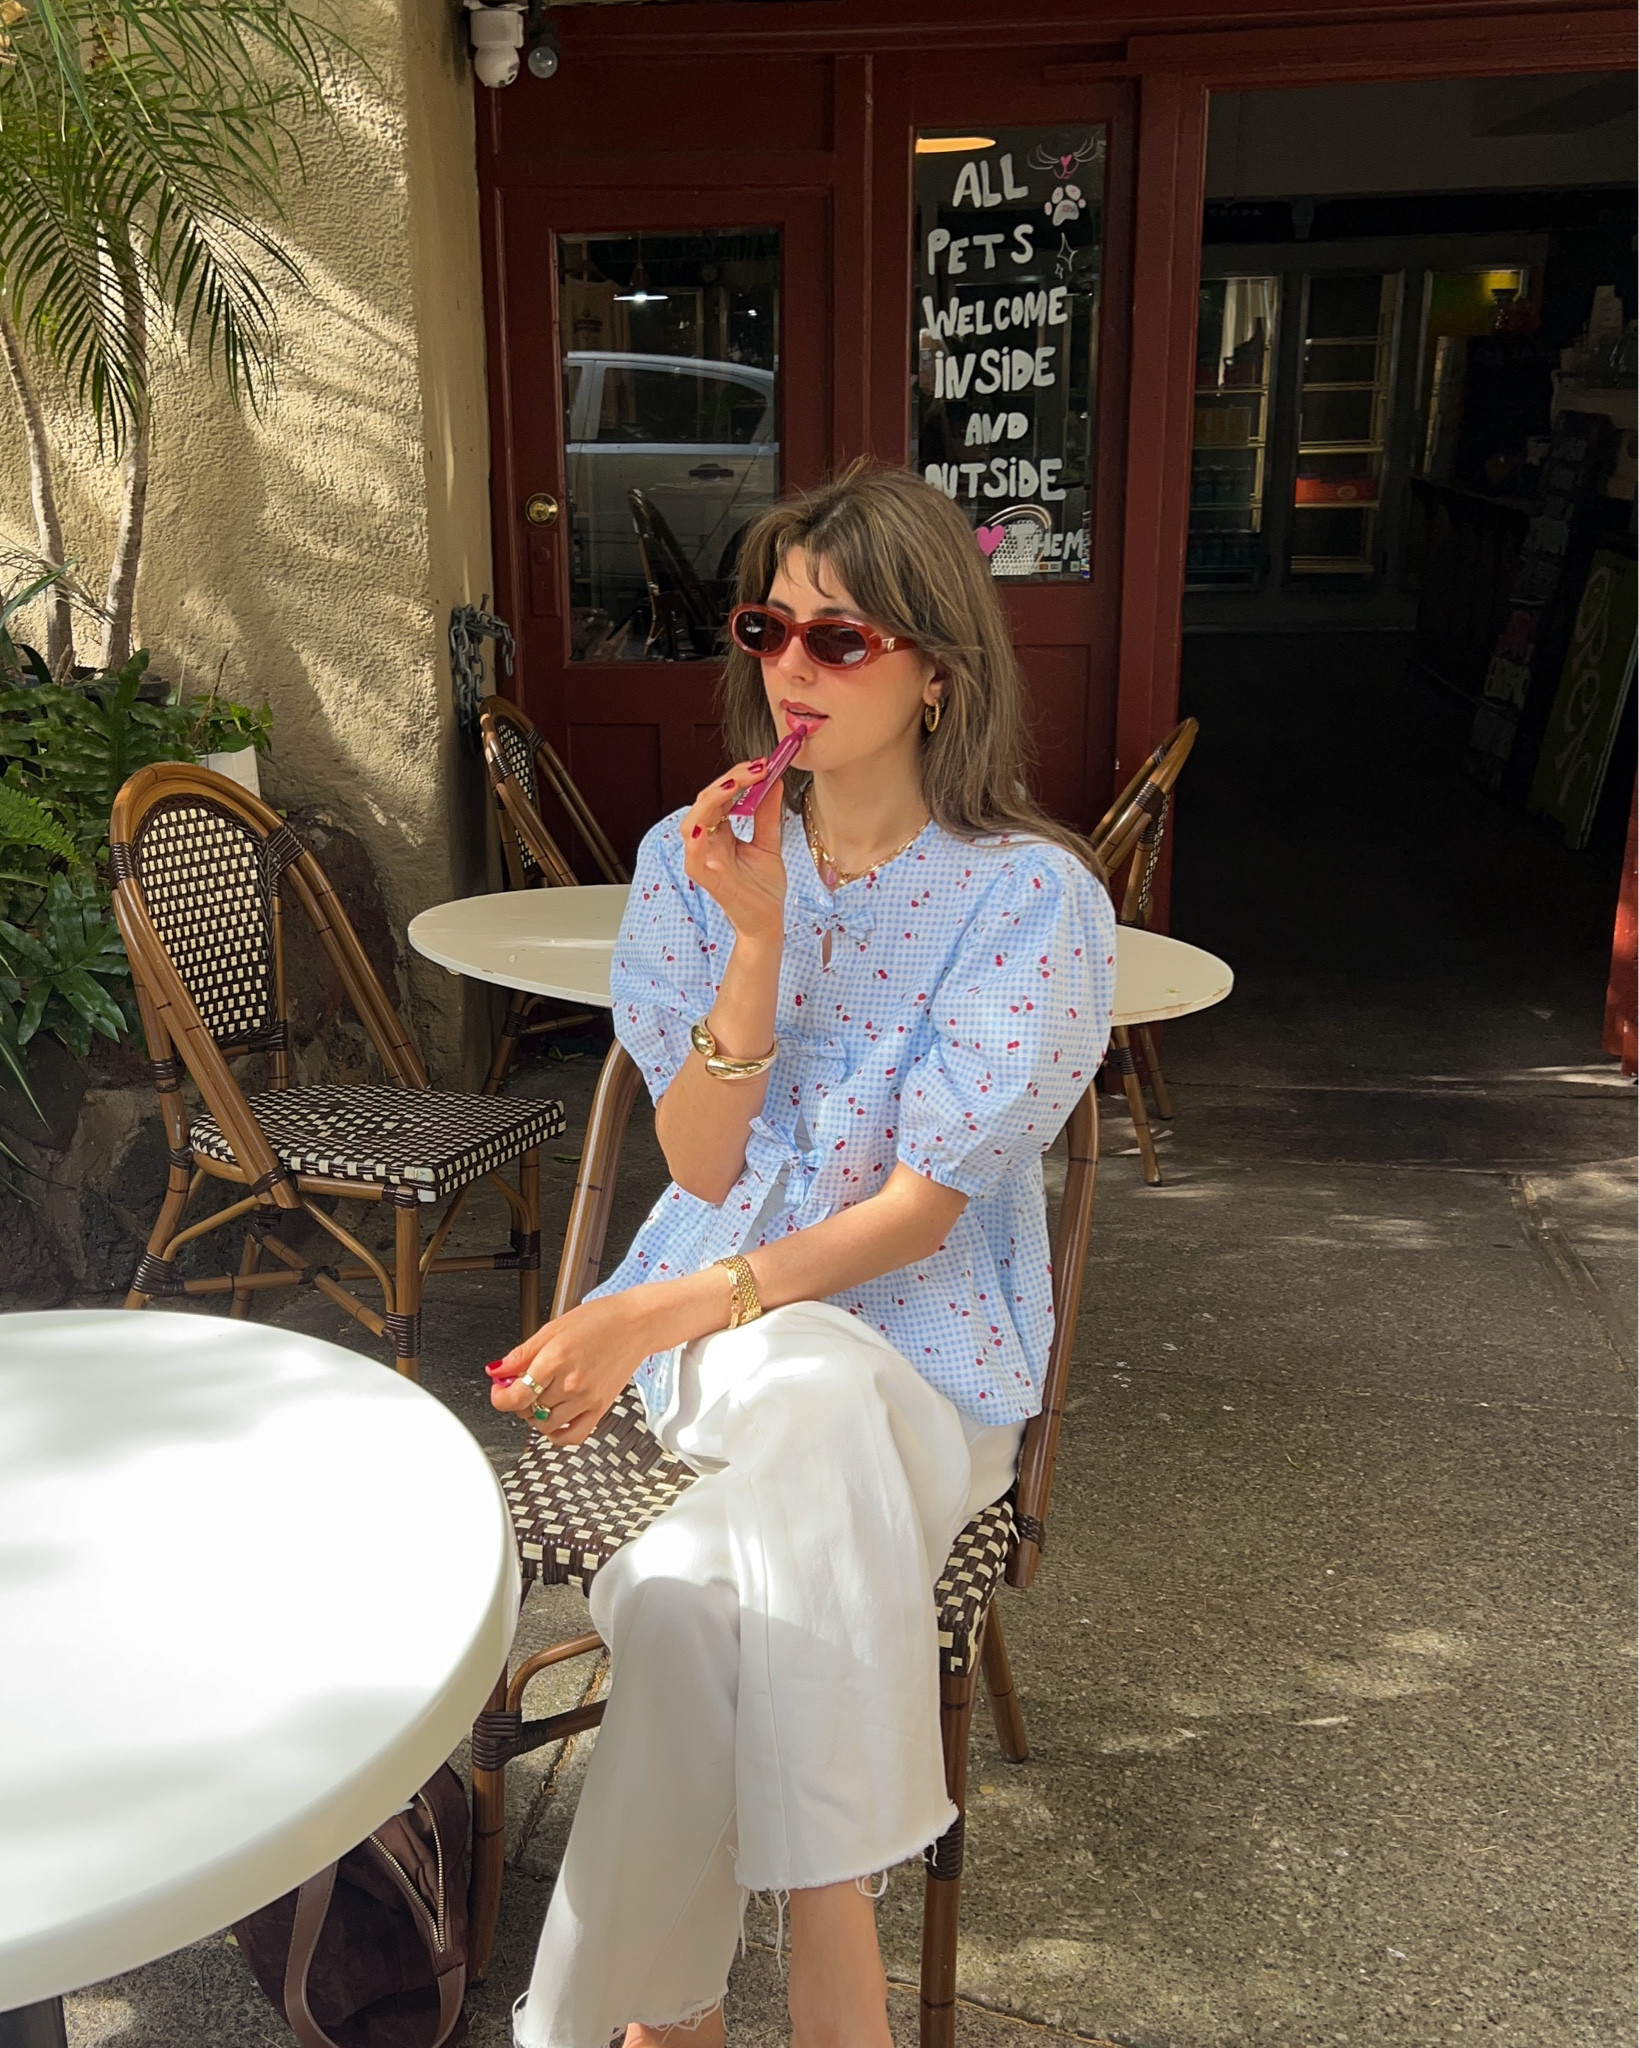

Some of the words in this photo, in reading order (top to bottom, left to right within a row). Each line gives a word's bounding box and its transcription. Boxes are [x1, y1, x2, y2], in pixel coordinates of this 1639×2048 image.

[952, 153, 1029, 208] ALL
[928, 224, 1034, 275] PETS
[922, 286, 1068, 340] WELCOME
[964, 412, 1028, 447] AND
[1010, 523, 1084, 560] THEM
